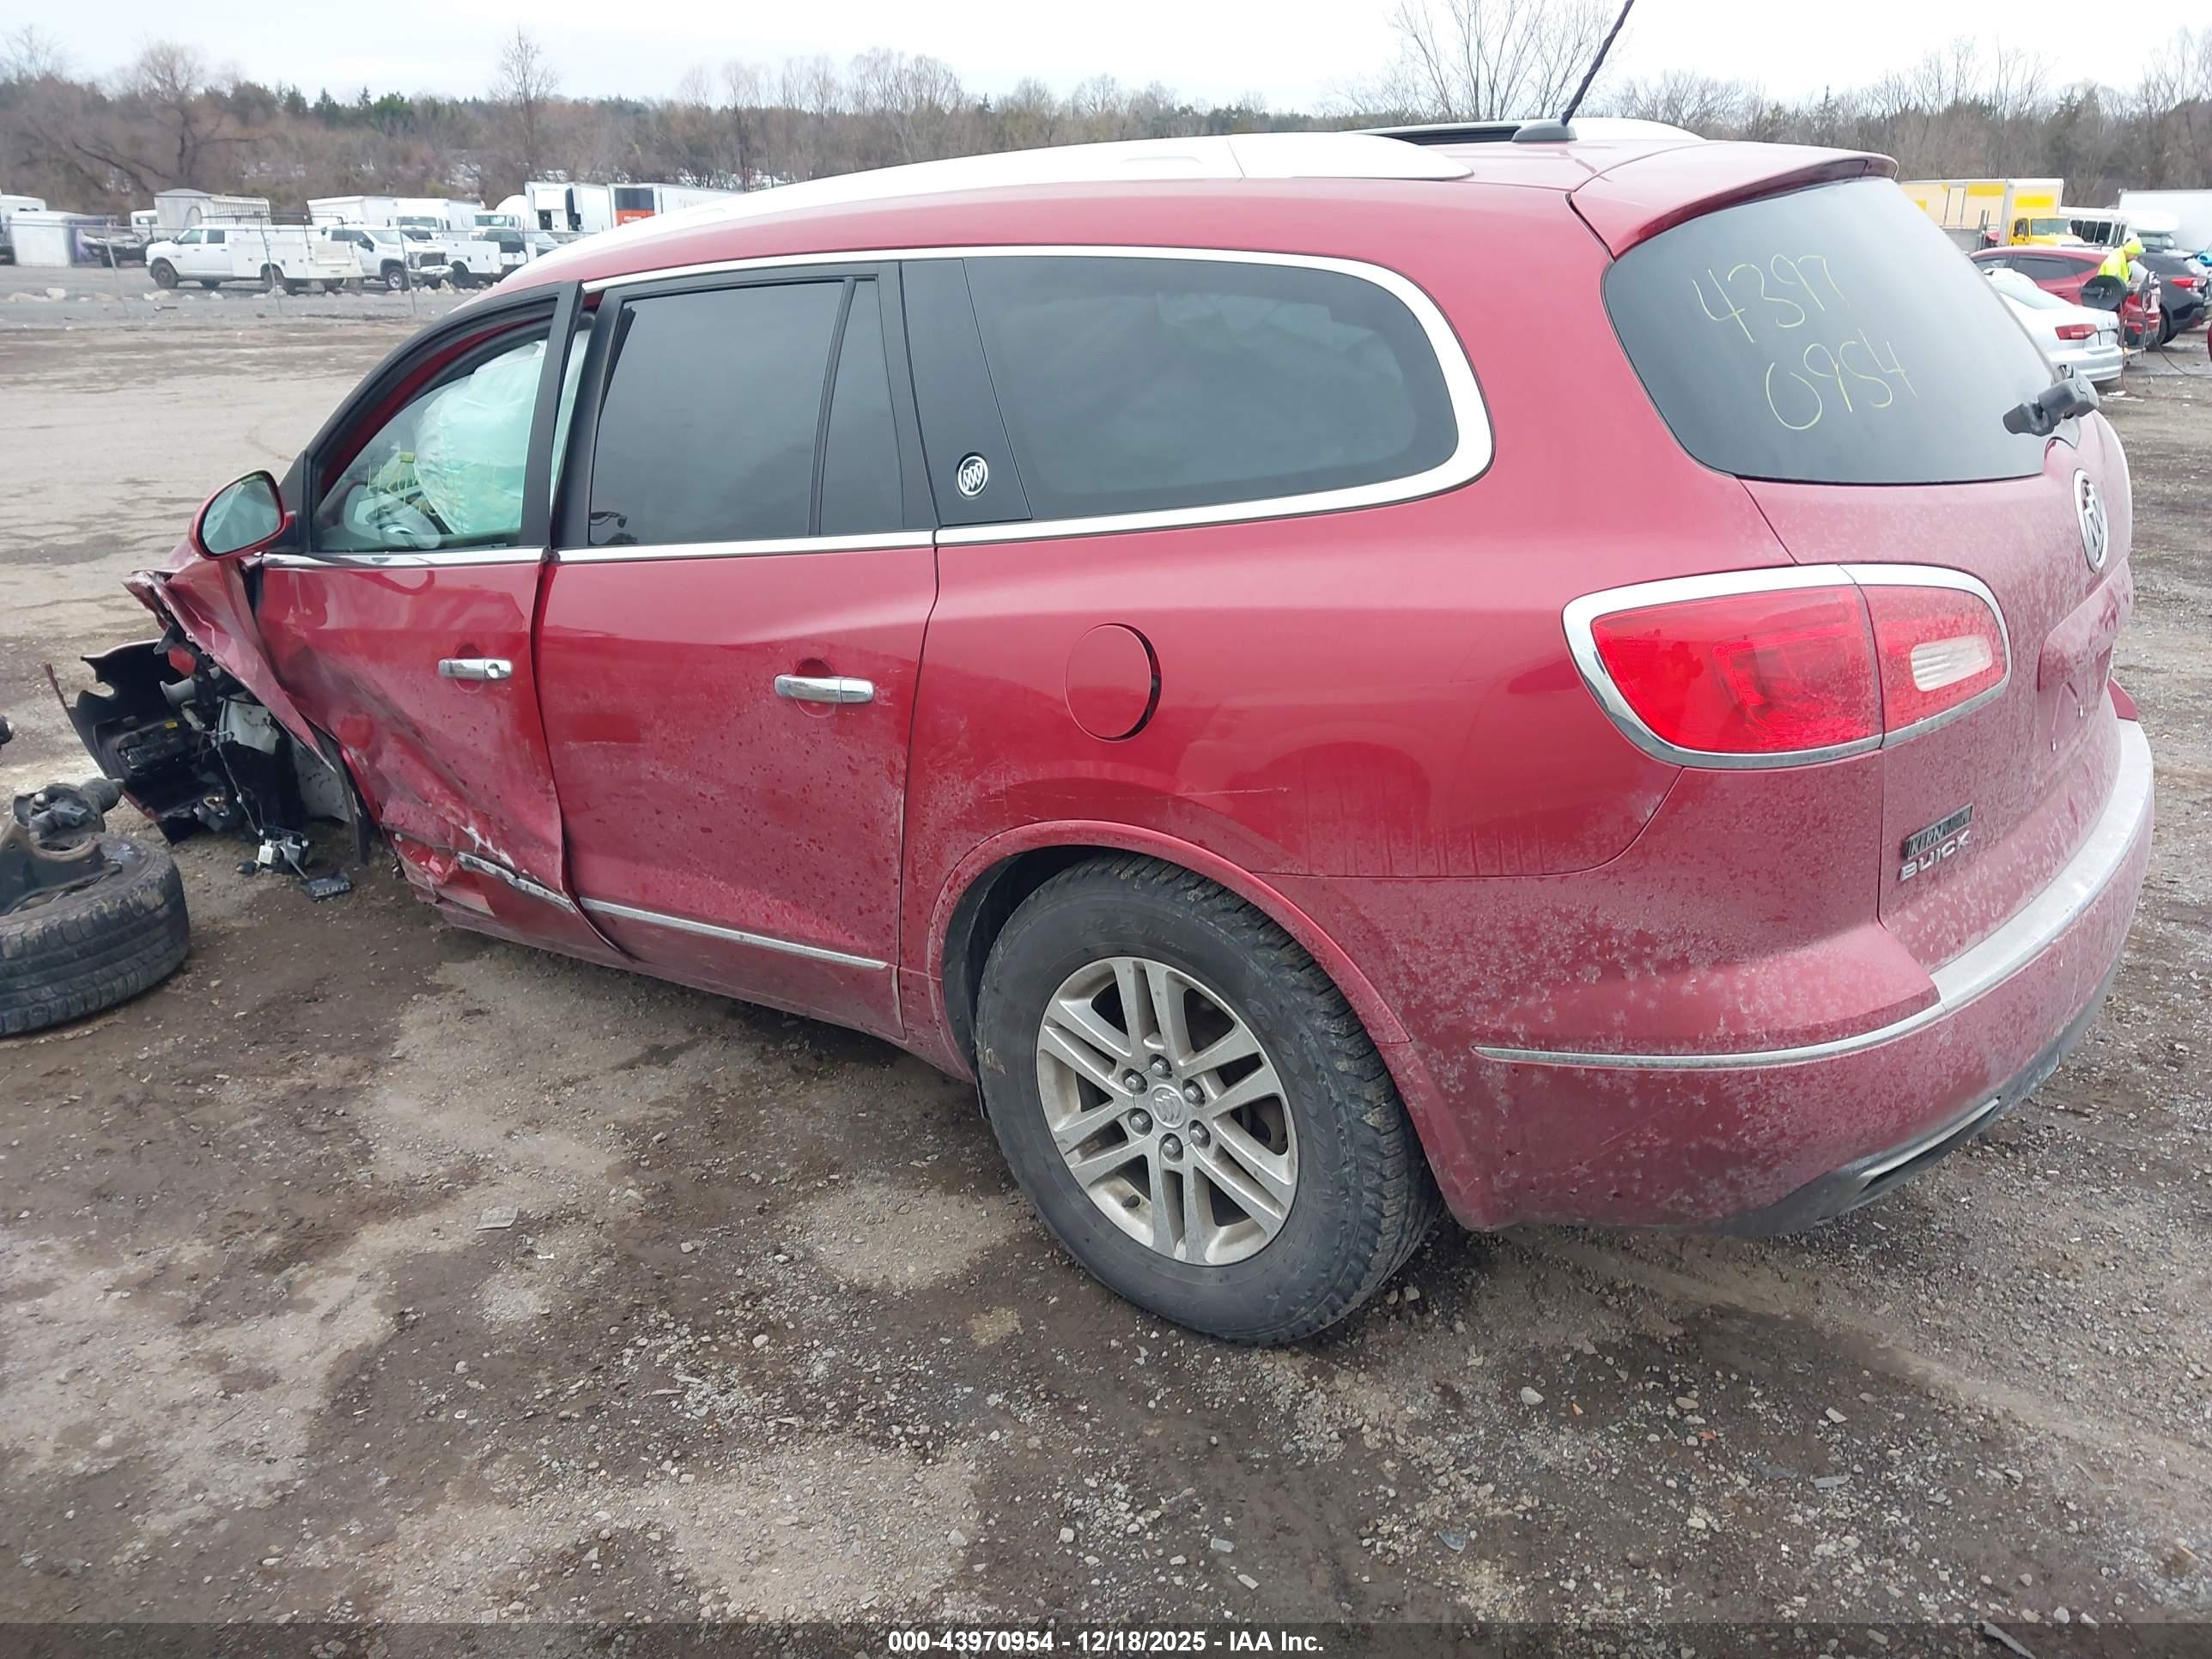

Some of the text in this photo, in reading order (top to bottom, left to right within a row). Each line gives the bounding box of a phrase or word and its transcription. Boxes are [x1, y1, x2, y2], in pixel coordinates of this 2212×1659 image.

[1692, 252, 1851, 343] 4397
[1765, 328, 1917, 430] 0954
[1899, 830, 1971, 881] BUICK
